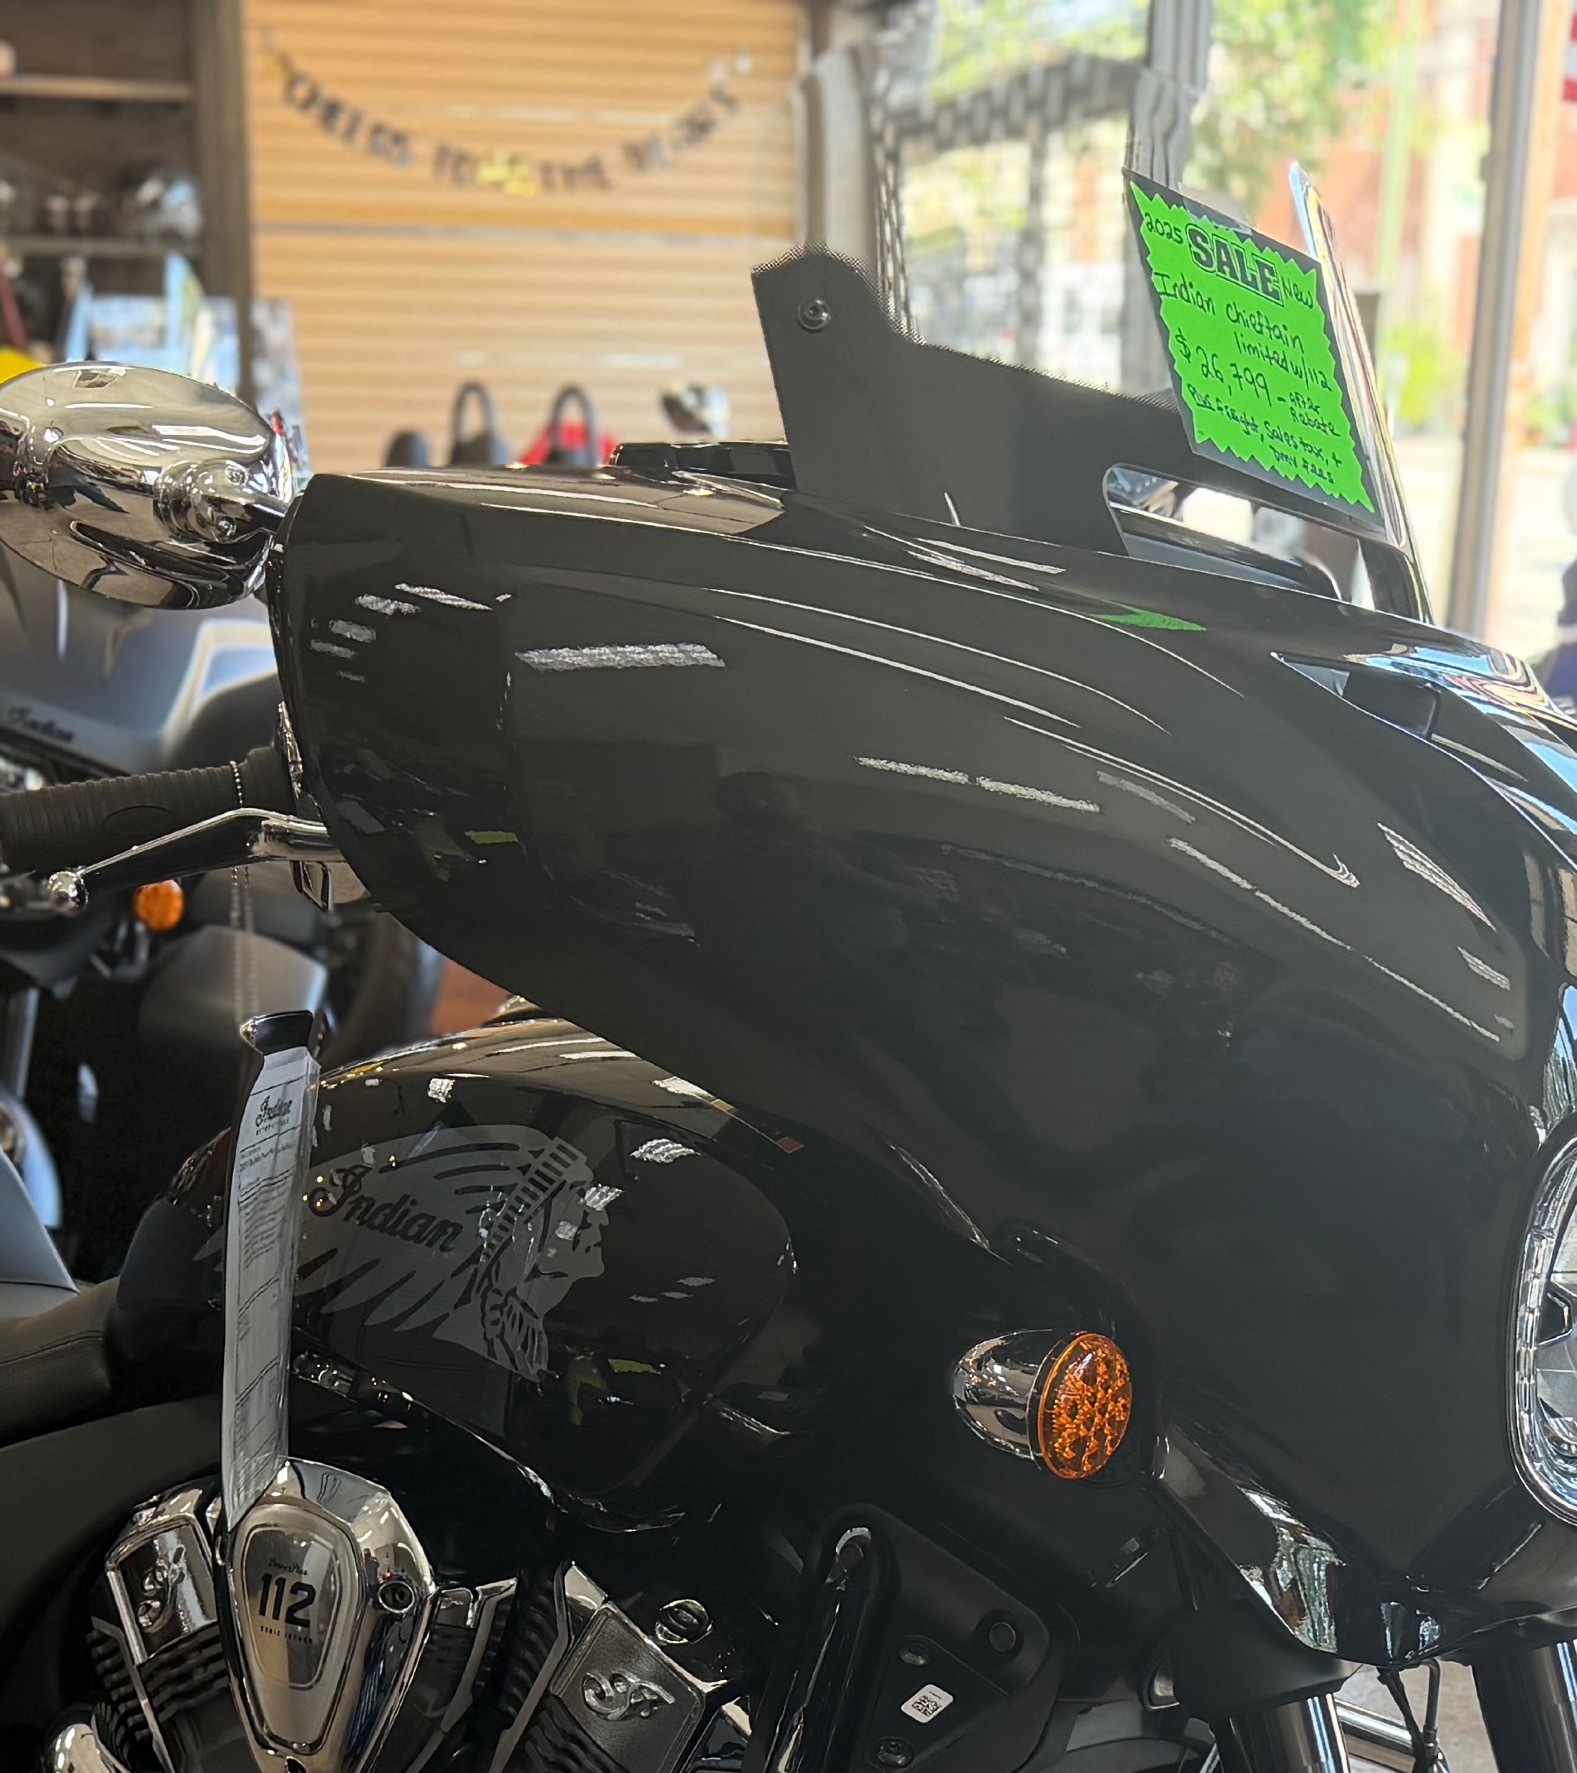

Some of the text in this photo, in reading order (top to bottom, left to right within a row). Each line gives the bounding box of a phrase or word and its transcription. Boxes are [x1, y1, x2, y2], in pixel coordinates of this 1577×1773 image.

[1145, 212, 1314, 309] 2025 SALE New
[1153, 271, 1216, 316] Indian
[308, 1164, 464, 1253] Indian
[259, 1572, 316, 1628] 112
